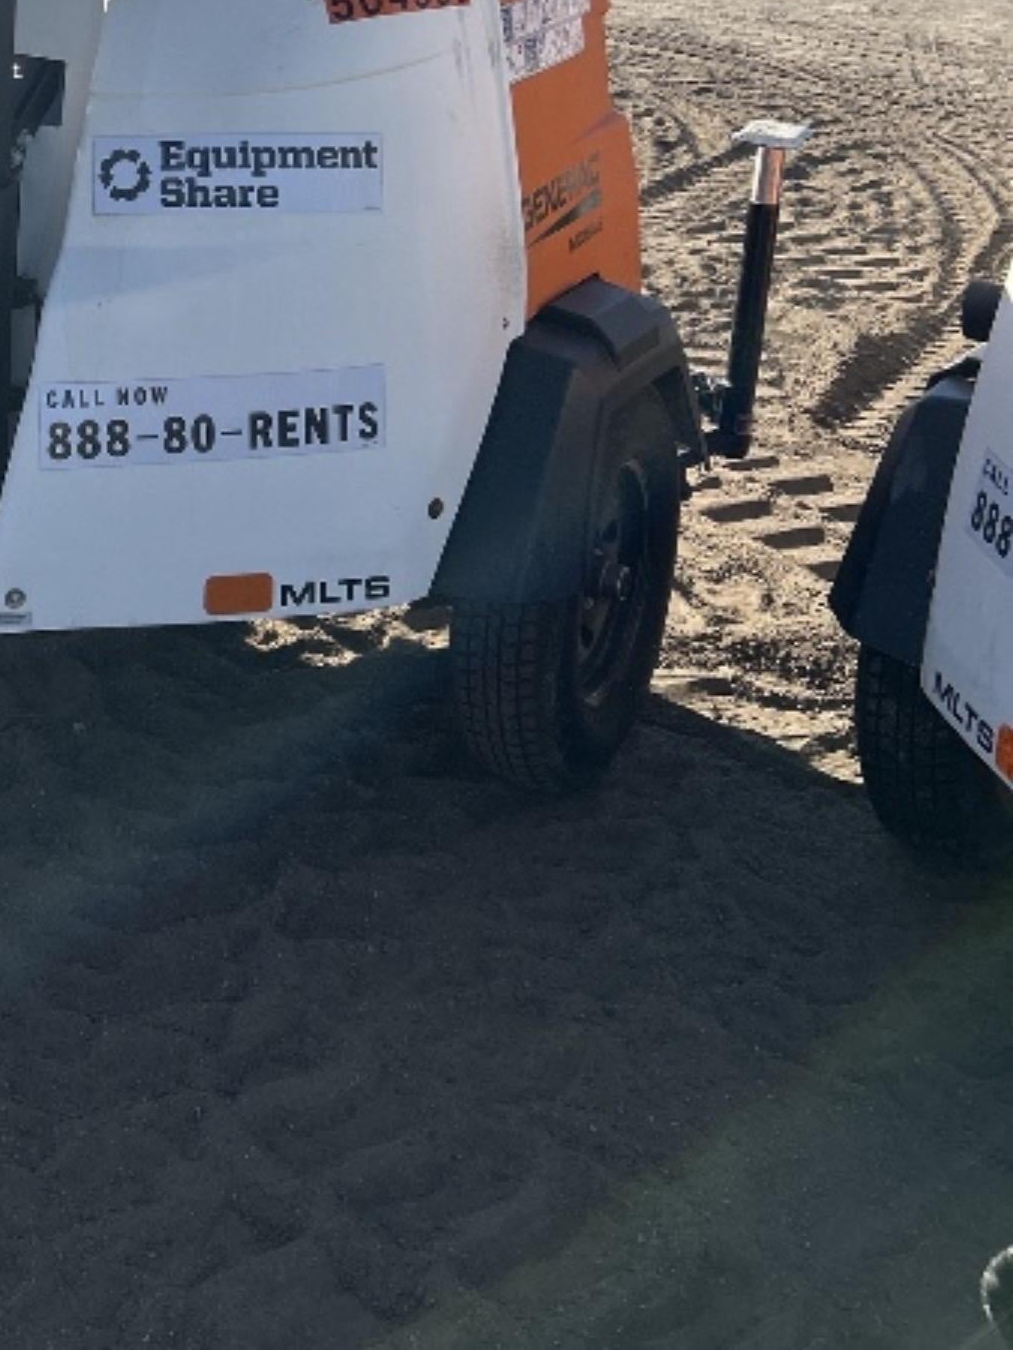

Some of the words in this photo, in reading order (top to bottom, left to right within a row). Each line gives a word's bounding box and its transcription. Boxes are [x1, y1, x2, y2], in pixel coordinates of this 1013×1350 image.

[158, 140, 378, 177] Equipment
[159, 176, 280, 208] Share
[46, 388, 106, 409] CALL
[116, 386, 169, 407] NOW
[47, 400, 380, 460] 888-80-RENTS
[280, 575, 391, 607] MLTS
[933, 671, 994, 754] MLTS
